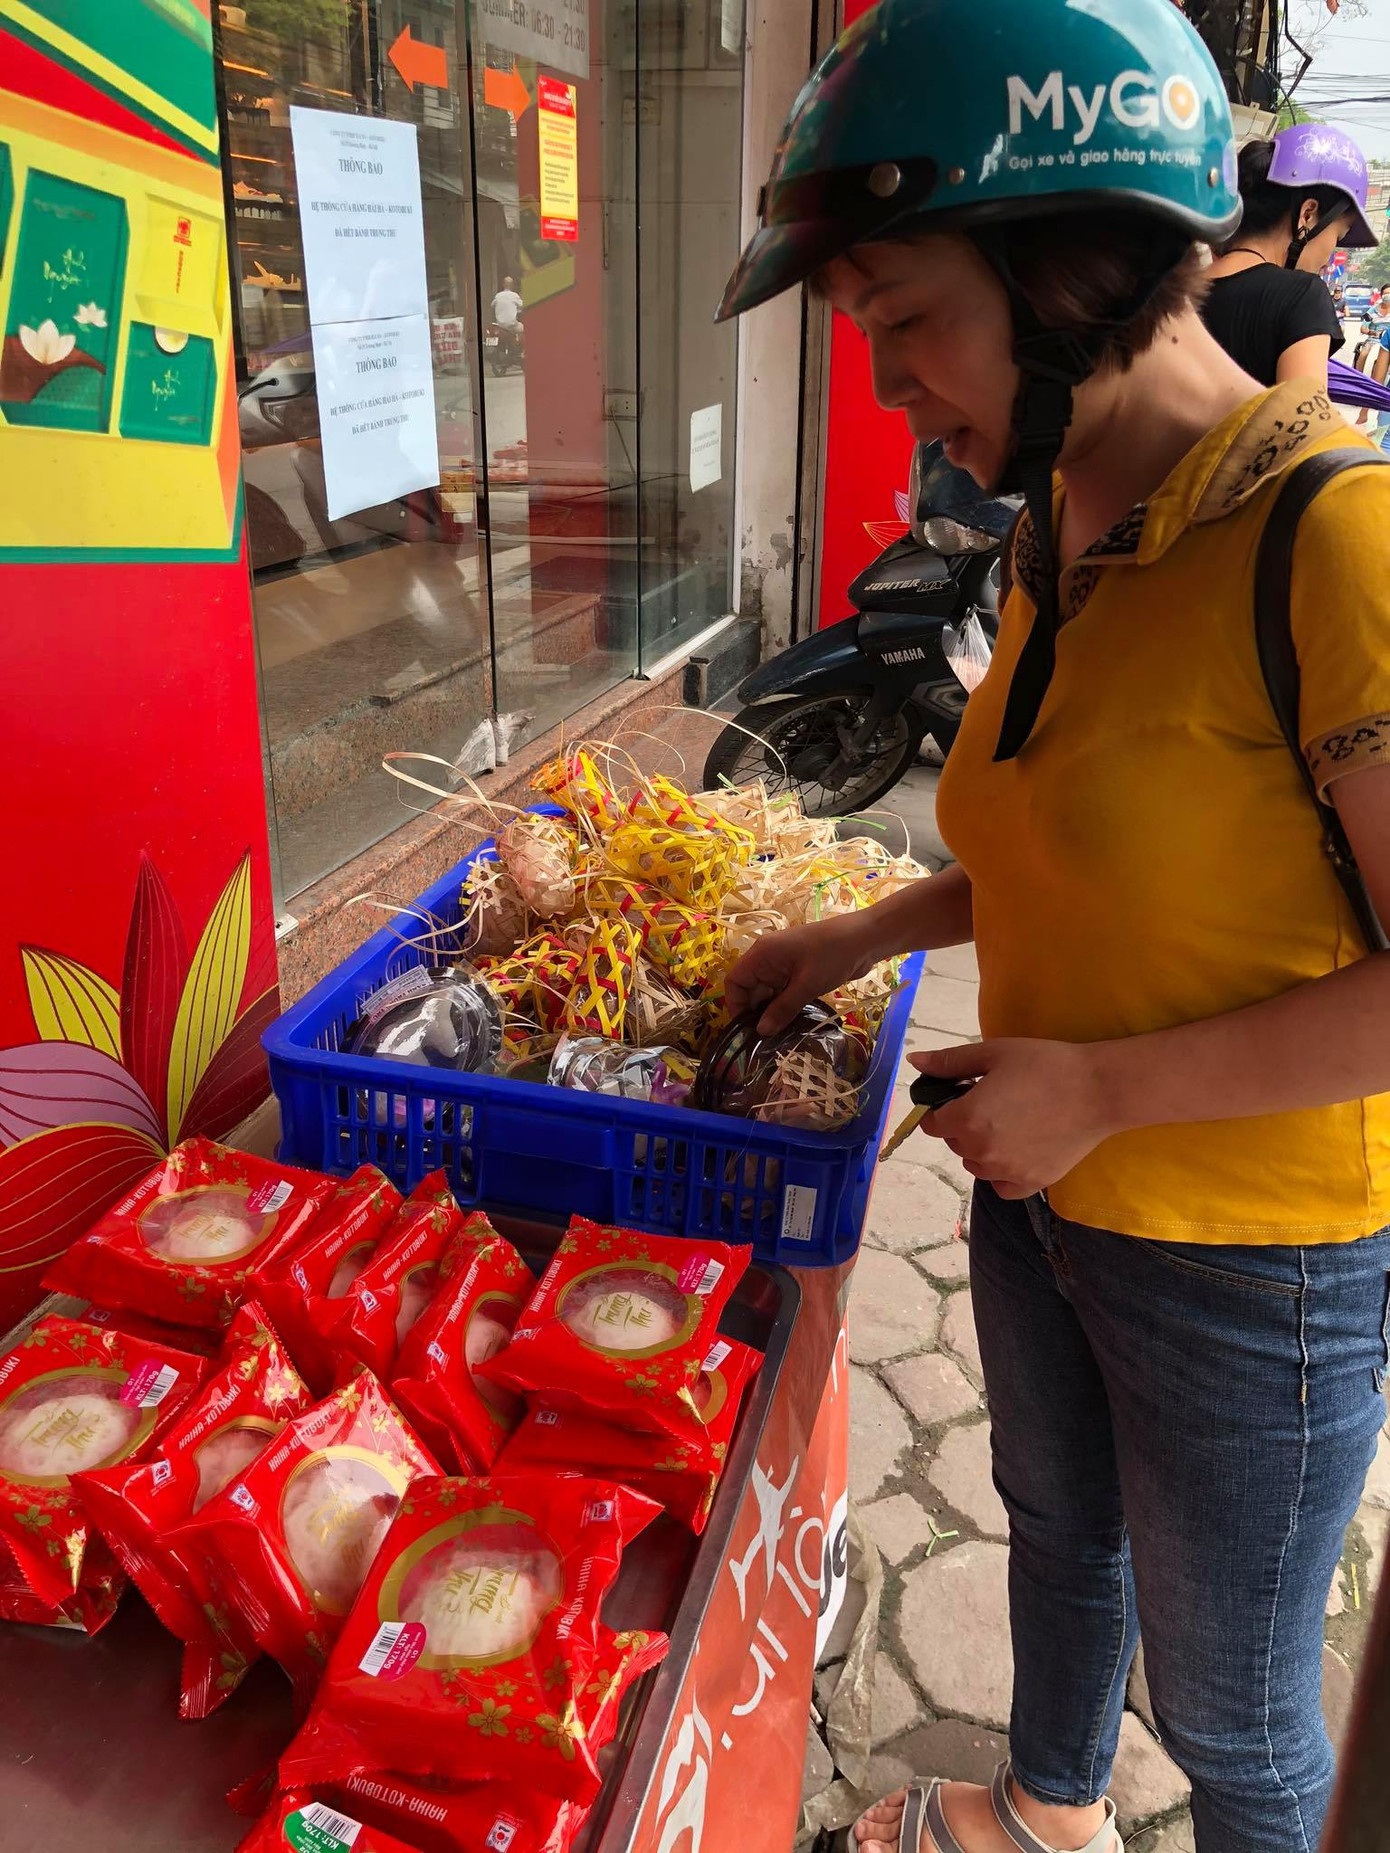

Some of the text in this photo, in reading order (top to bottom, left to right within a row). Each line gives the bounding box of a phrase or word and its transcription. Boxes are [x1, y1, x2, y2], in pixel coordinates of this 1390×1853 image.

[563, 22, 586, 52] 21:30
[1006, 69, 1201, 146] MyGO
[338, 156, 367, 174] THÔNG
[1008, 156, 1033, 173] Gọi
[1037, 154, 1054, 166] xe
[1059, 150, 1075, 165] và
[1080, 150, 1109, 167] giao
[1113, 148, 1146, 166] hàng
[356, 357, 382, 374] THÔNG
[880, 647, 926, 665] YAMAHA
[324, 1210, 369, 1259] HAIHA-KOTOBUKI
[382, 1230, 428, 1282] HAIHA-KOTOBUKI
[696, 1263, 708, 1277] 170g
[529, 1259, 563, 1313] HAIHA-KOTOBUKI
[135, 1387, 149, 1401] KLT:
[144, 1370, 160, 1387] 170g
[178, 1383, 241, 1451] HAIHA-KOTOBUKI
[396, 1632, 411, 1649] KLT:
[383, 1650, 401, 1670] 170g
[346, 1776, 448, 1822] HAIHA-KOTOBUKI
[301, 1819, 322, 1839] 170g
[321, 1833, 340, 1850] KLT:
